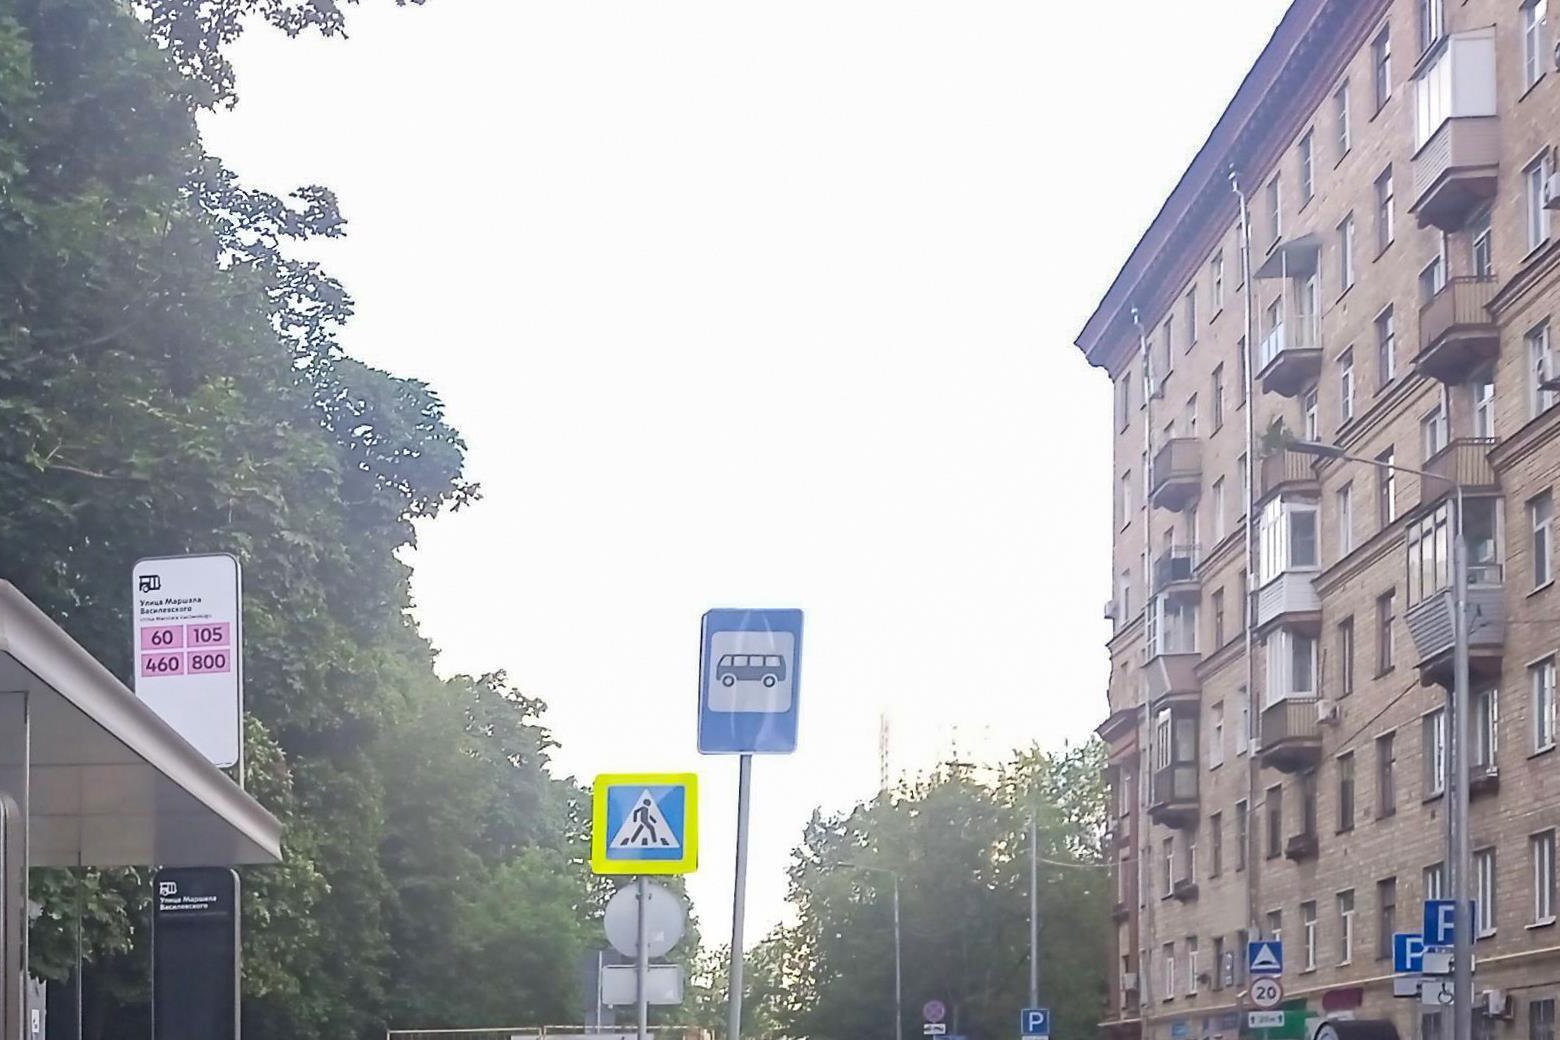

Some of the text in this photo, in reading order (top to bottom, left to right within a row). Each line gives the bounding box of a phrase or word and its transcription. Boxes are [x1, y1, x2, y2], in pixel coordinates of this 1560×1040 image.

[151, 627, 223, 646] 60 105
[145, 654, 226, 672] 460 800
[1256, 986, 1277, 1000] 20
[1028, 1012, 1044, 1032] P
